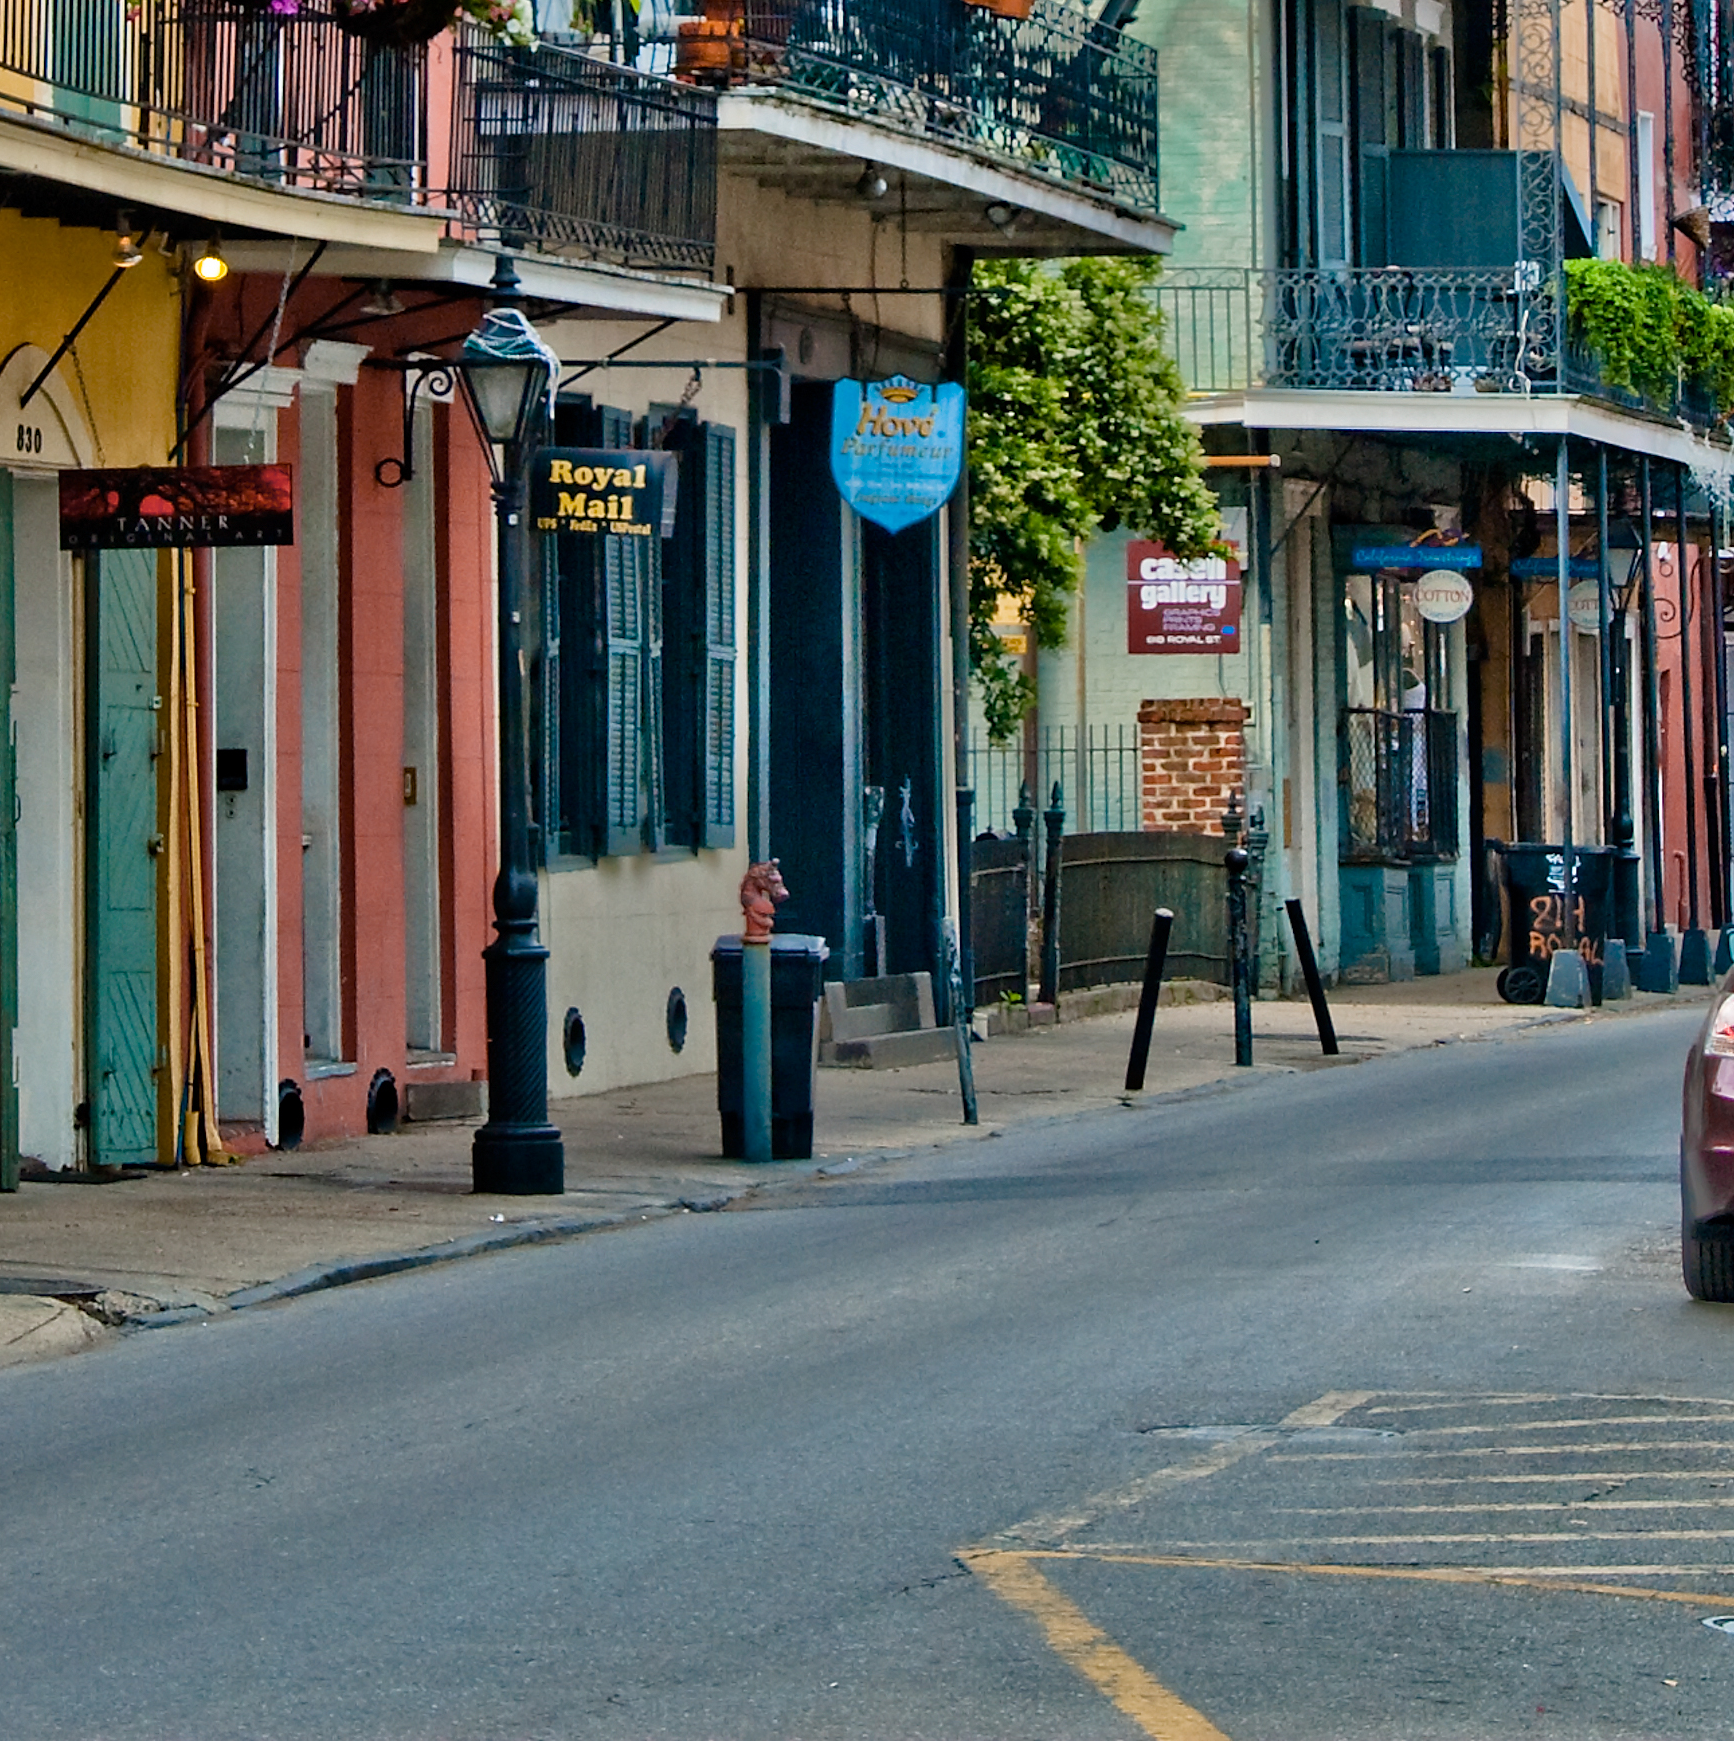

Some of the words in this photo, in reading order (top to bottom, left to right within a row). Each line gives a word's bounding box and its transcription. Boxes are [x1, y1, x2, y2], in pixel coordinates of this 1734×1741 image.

[16, 424, 43, 453] 830
[548, 458, 647, 492] Royal
[557, 491, 634, 520] Mail
[116, 515, 230, 532] TANNER
[1139, 580, 1228, 611] gallery
[1415, 589, 1471, 603] COTTON
[1528, 930, 1605, 967] ROAL
